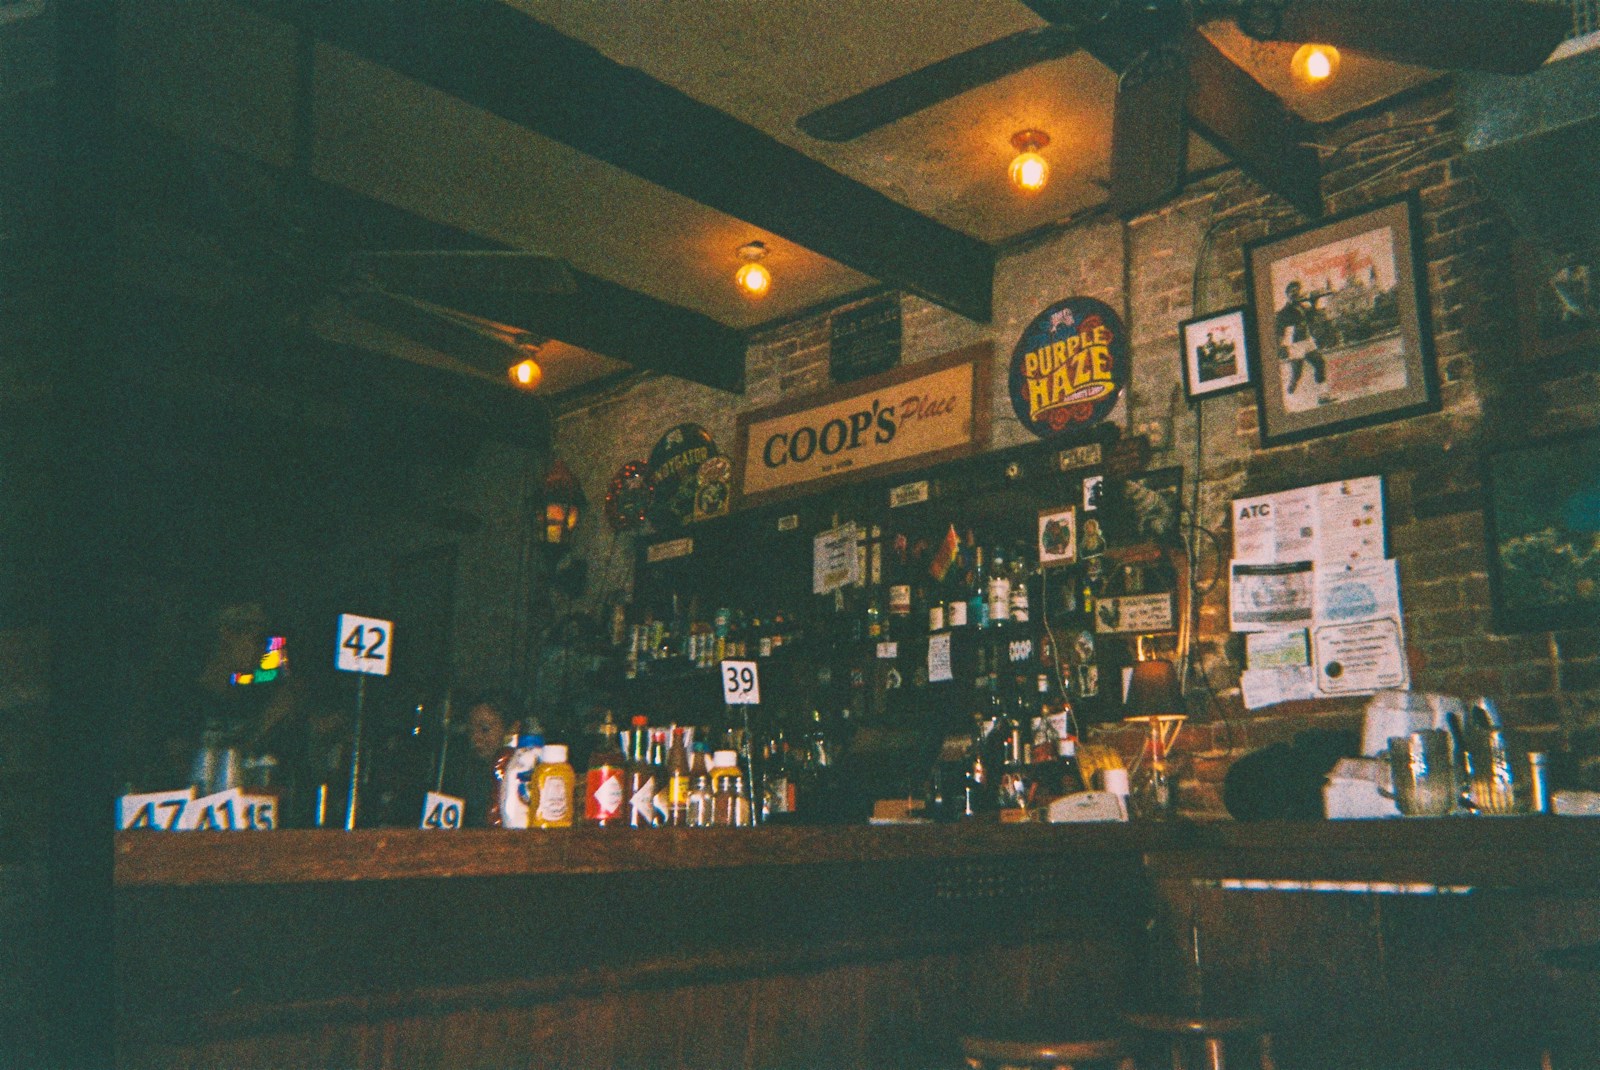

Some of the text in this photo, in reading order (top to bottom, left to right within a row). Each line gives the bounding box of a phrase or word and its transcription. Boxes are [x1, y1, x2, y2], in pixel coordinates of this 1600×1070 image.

[1025, 325, 1107, 377] PURPLE
[1027, 346, 1112, 418] HAZE
[763, 394, 957, 468] COOP'S Place
[1239, 503, 1271, 520] ATC
[342, 624, 386, 660] 42
[726, 666, 755, 693] 39
